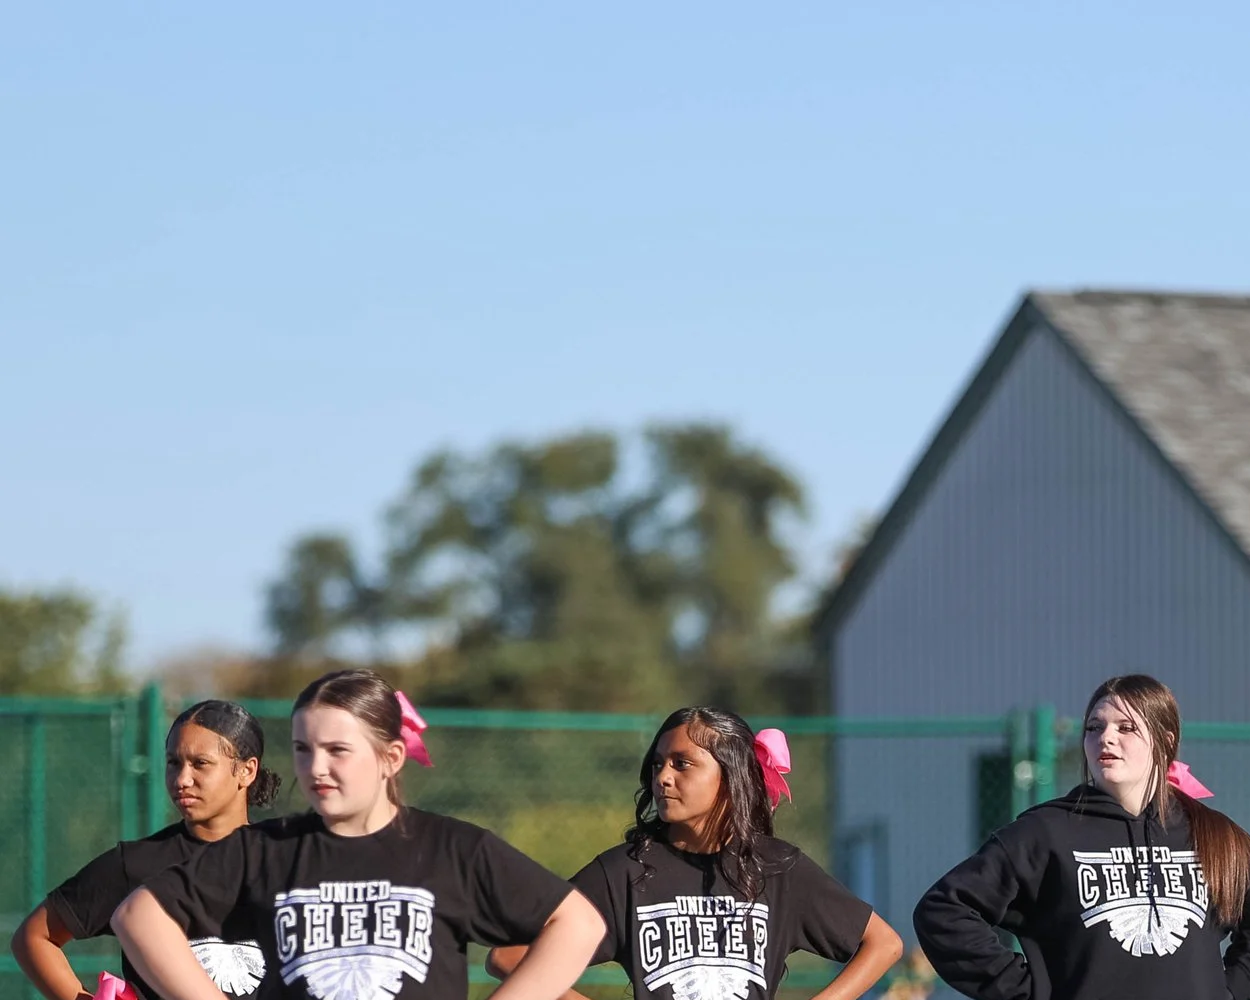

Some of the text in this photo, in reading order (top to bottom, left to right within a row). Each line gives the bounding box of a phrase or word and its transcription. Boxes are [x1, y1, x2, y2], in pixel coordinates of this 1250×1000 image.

[1110, 846, 1171, 864] UNITED
[319, 880, 391, 903] UNITED
[675, 895, 736, 916] UNITED
[274, 900, 434, 965] CHEER
